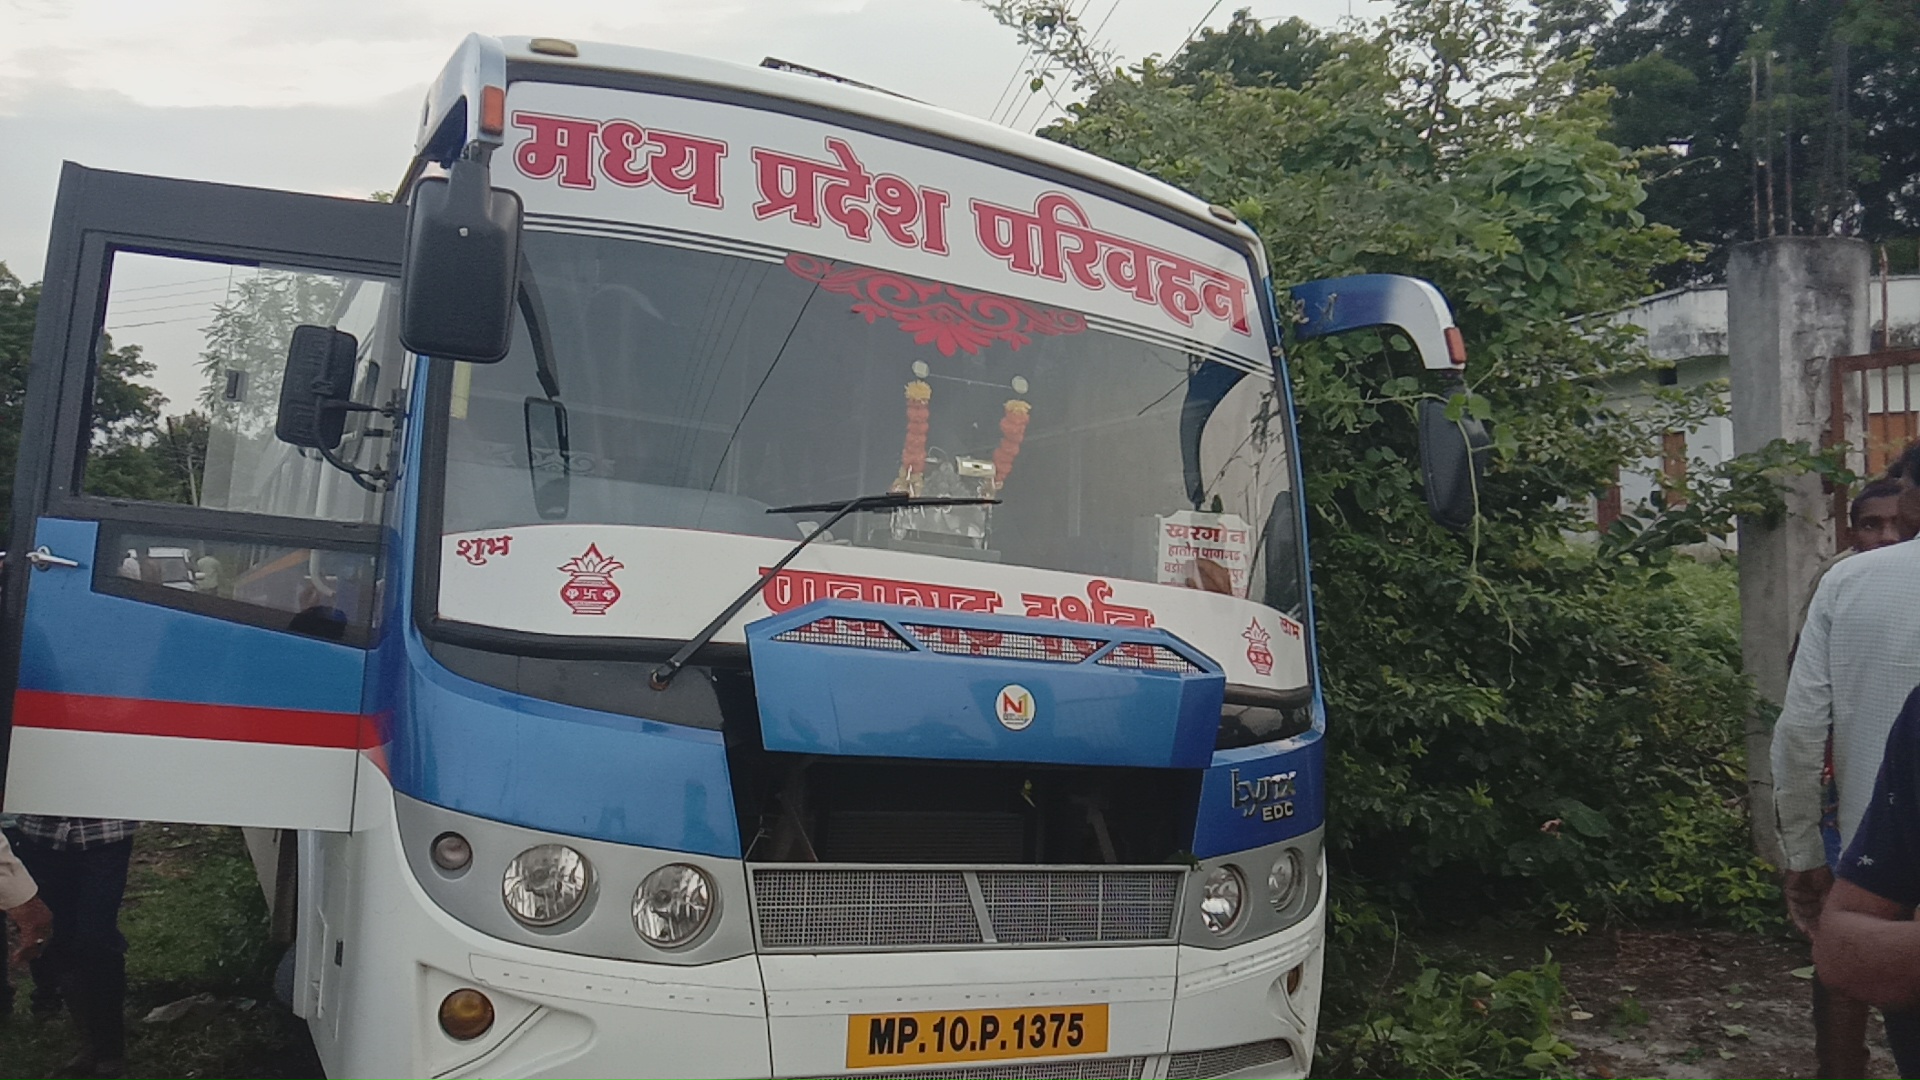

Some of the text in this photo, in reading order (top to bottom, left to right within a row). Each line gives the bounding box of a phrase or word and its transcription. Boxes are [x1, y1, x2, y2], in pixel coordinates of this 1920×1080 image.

[512, 110, 1251, 336] मध्य प्रदेश परिवहन
[456, 535, 513, 566] शुभ
[1262, 801, 1294, 822] EDC
[868, 1013, 1085, 1055] MP.10.P.1375
